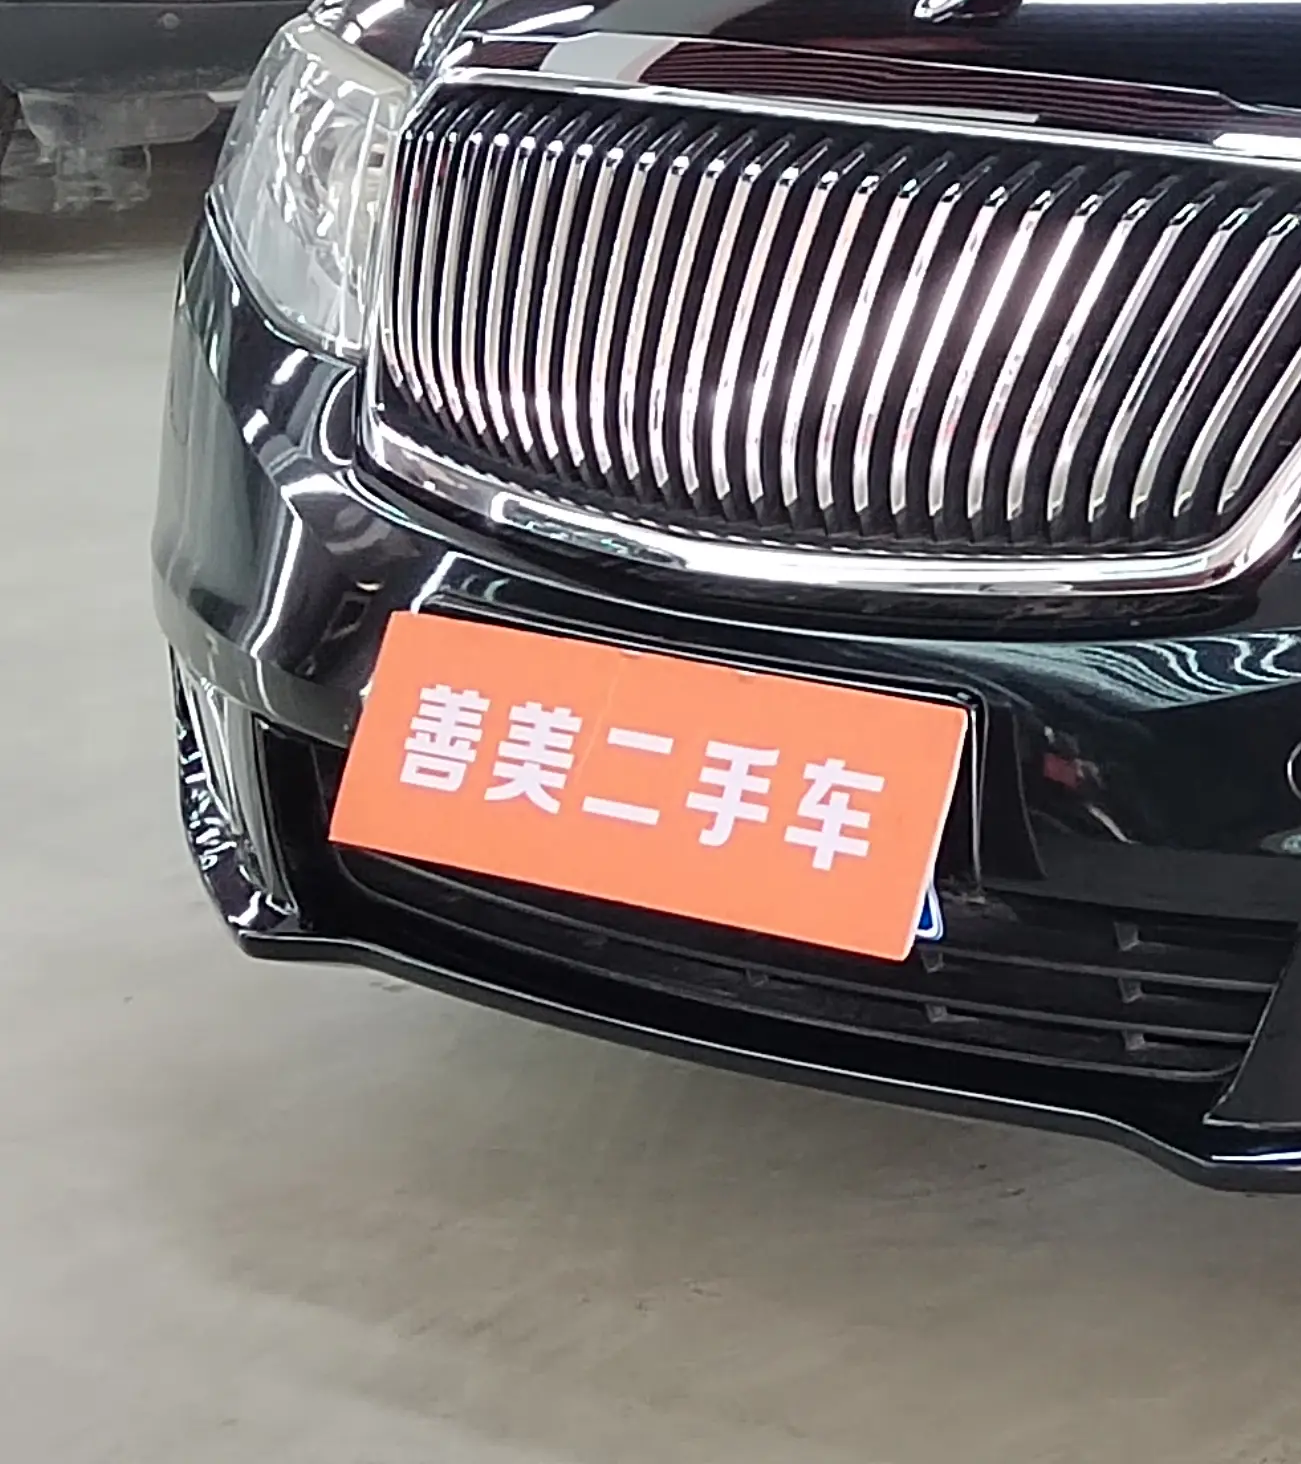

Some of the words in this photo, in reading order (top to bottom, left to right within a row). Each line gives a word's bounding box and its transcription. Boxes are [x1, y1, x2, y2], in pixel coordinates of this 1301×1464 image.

[399, 683, 885, 872] 善美二手车
